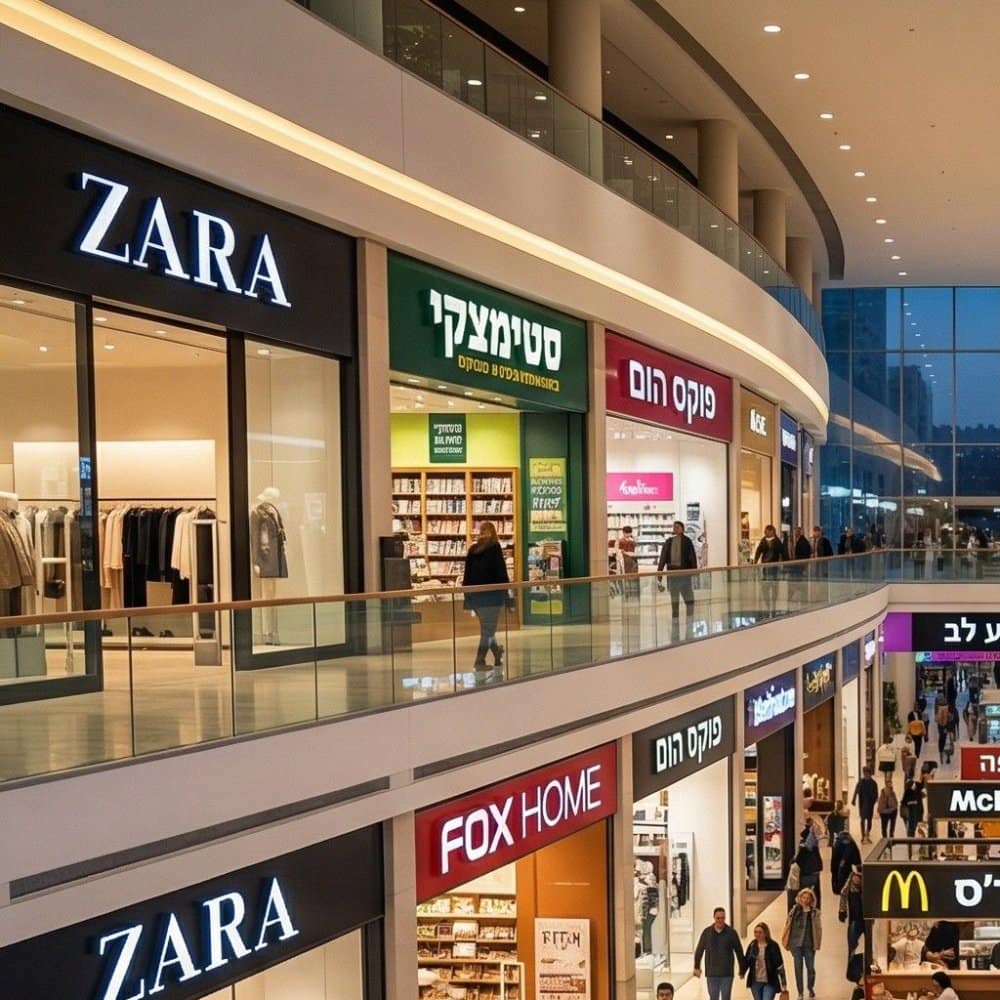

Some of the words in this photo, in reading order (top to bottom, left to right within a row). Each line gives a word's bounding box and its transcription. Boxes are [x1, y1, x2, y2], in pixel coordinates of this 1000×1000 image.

[79, 172, 292, 308] ZARA
[429, 288, 562, 371] סטימצקי
[629, 359, 667, 407] הום
[672, 375, 716, 425] פוקס
[943, 616, 976, 642] לב
[656, 731, 683, 773] הום
[687, 715, 721, 763] פוקס
[441, 796, 515, 875] FOX
[522, 764, 602, 839] HOME
